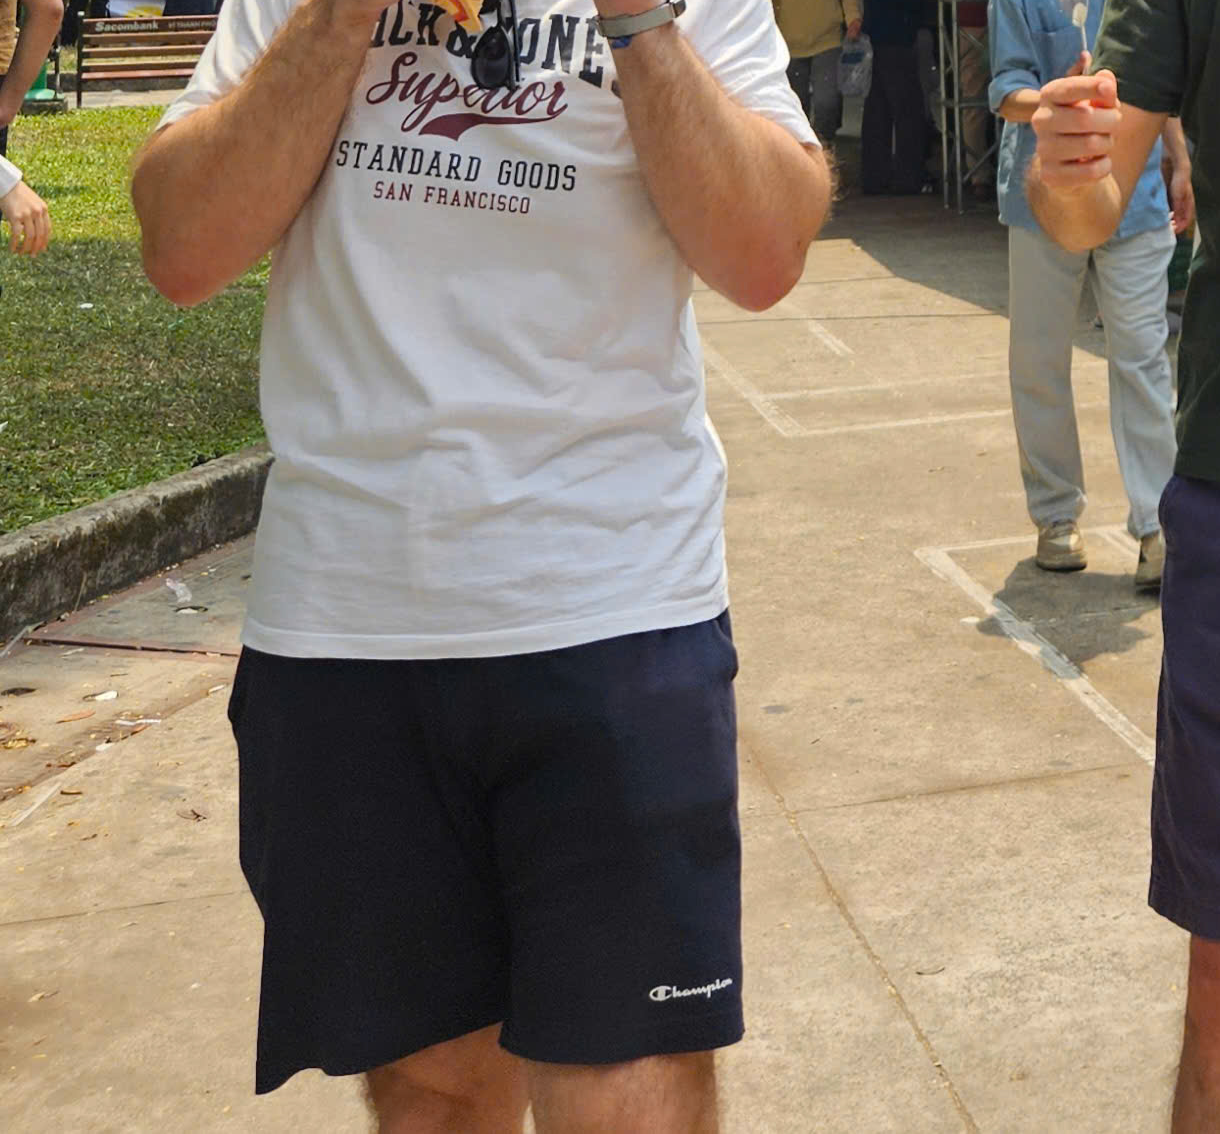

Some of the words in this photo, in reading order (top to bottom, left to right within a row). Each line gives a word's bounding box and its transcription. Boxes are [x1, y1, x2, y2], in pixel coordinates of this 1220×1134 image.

[95, 21, 159, 33] Sacombank
[336, 140, 482, 183] STANDARD
[497, 159, 577, 192] GOODS
[373, 181, 414, 202] SAN
[424, 186, 531, 214] FRANCISCO
